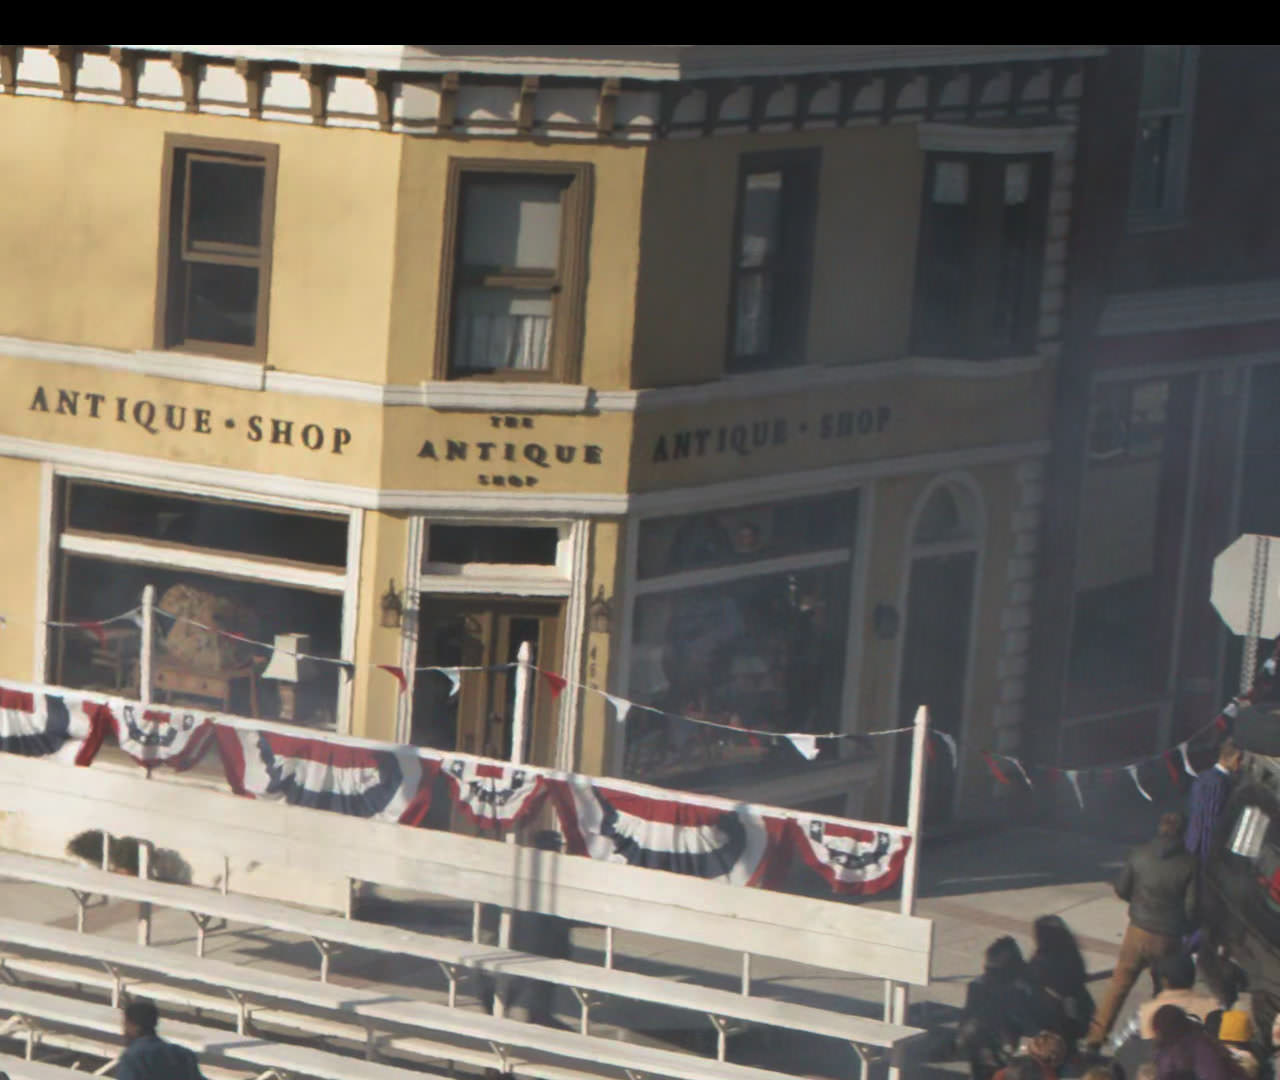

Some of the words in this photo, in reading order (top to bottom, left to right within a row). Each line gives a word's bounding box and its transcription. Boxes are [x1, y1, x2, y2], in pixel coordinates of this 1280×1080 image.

[28, 385, 213, 436] ANTIQUE
[246, 414, 353, 455] SHOP
[490, 415, 535, 429] THE
[652, 417, 788, 464] ANTIQUE
[819, 406, 892, 441] SHOP
[416, 439, 604, 468] ANTIQUE
[477, 473, 539, 488] SHOP
